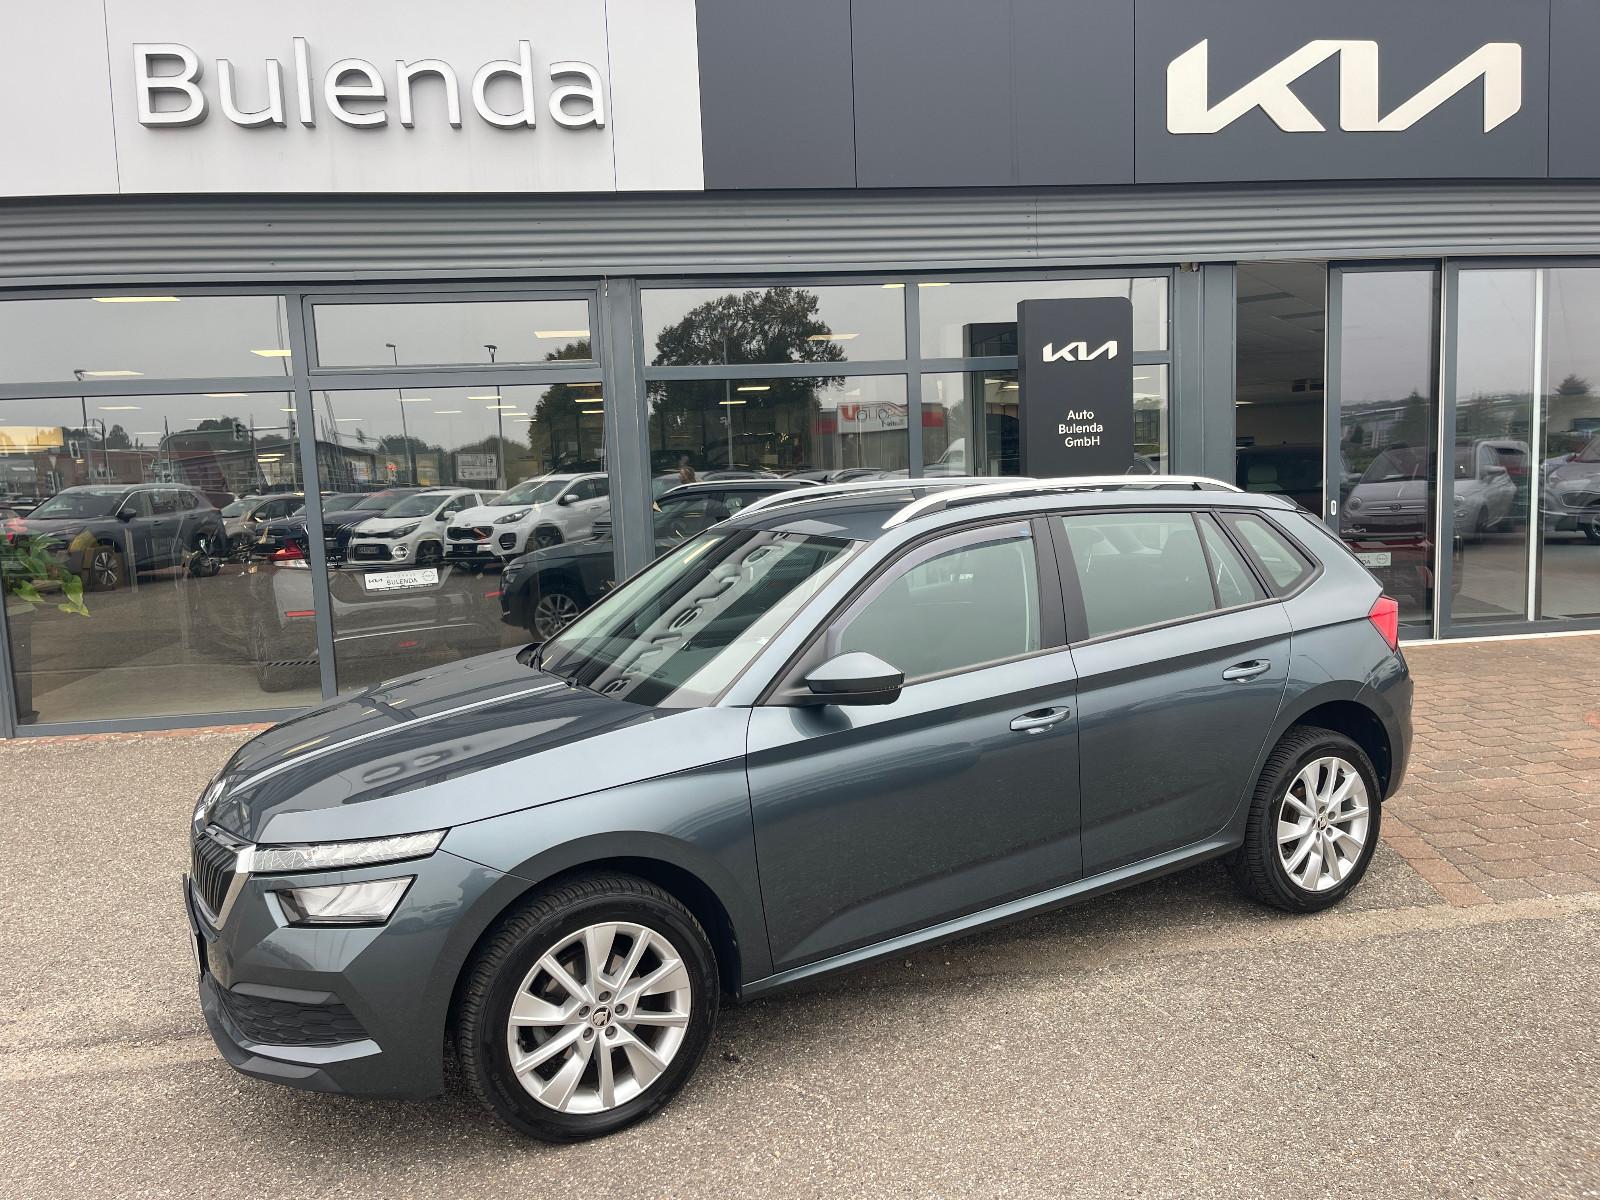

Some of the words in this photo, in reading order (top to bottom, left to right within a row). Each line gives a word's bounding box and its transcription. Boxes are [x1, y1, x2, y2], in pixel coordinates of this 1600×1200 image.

[132, 36, 606, 129] Bulenda
[1166, 38, 1522, 135] KIA
[1042, 340, 1118, 362] KIA
[1066, 409, 1095, 421] Auto
[1058, 422, 1104, 434] Bulenda
[1064, 436, 1100, 448] GmbH
